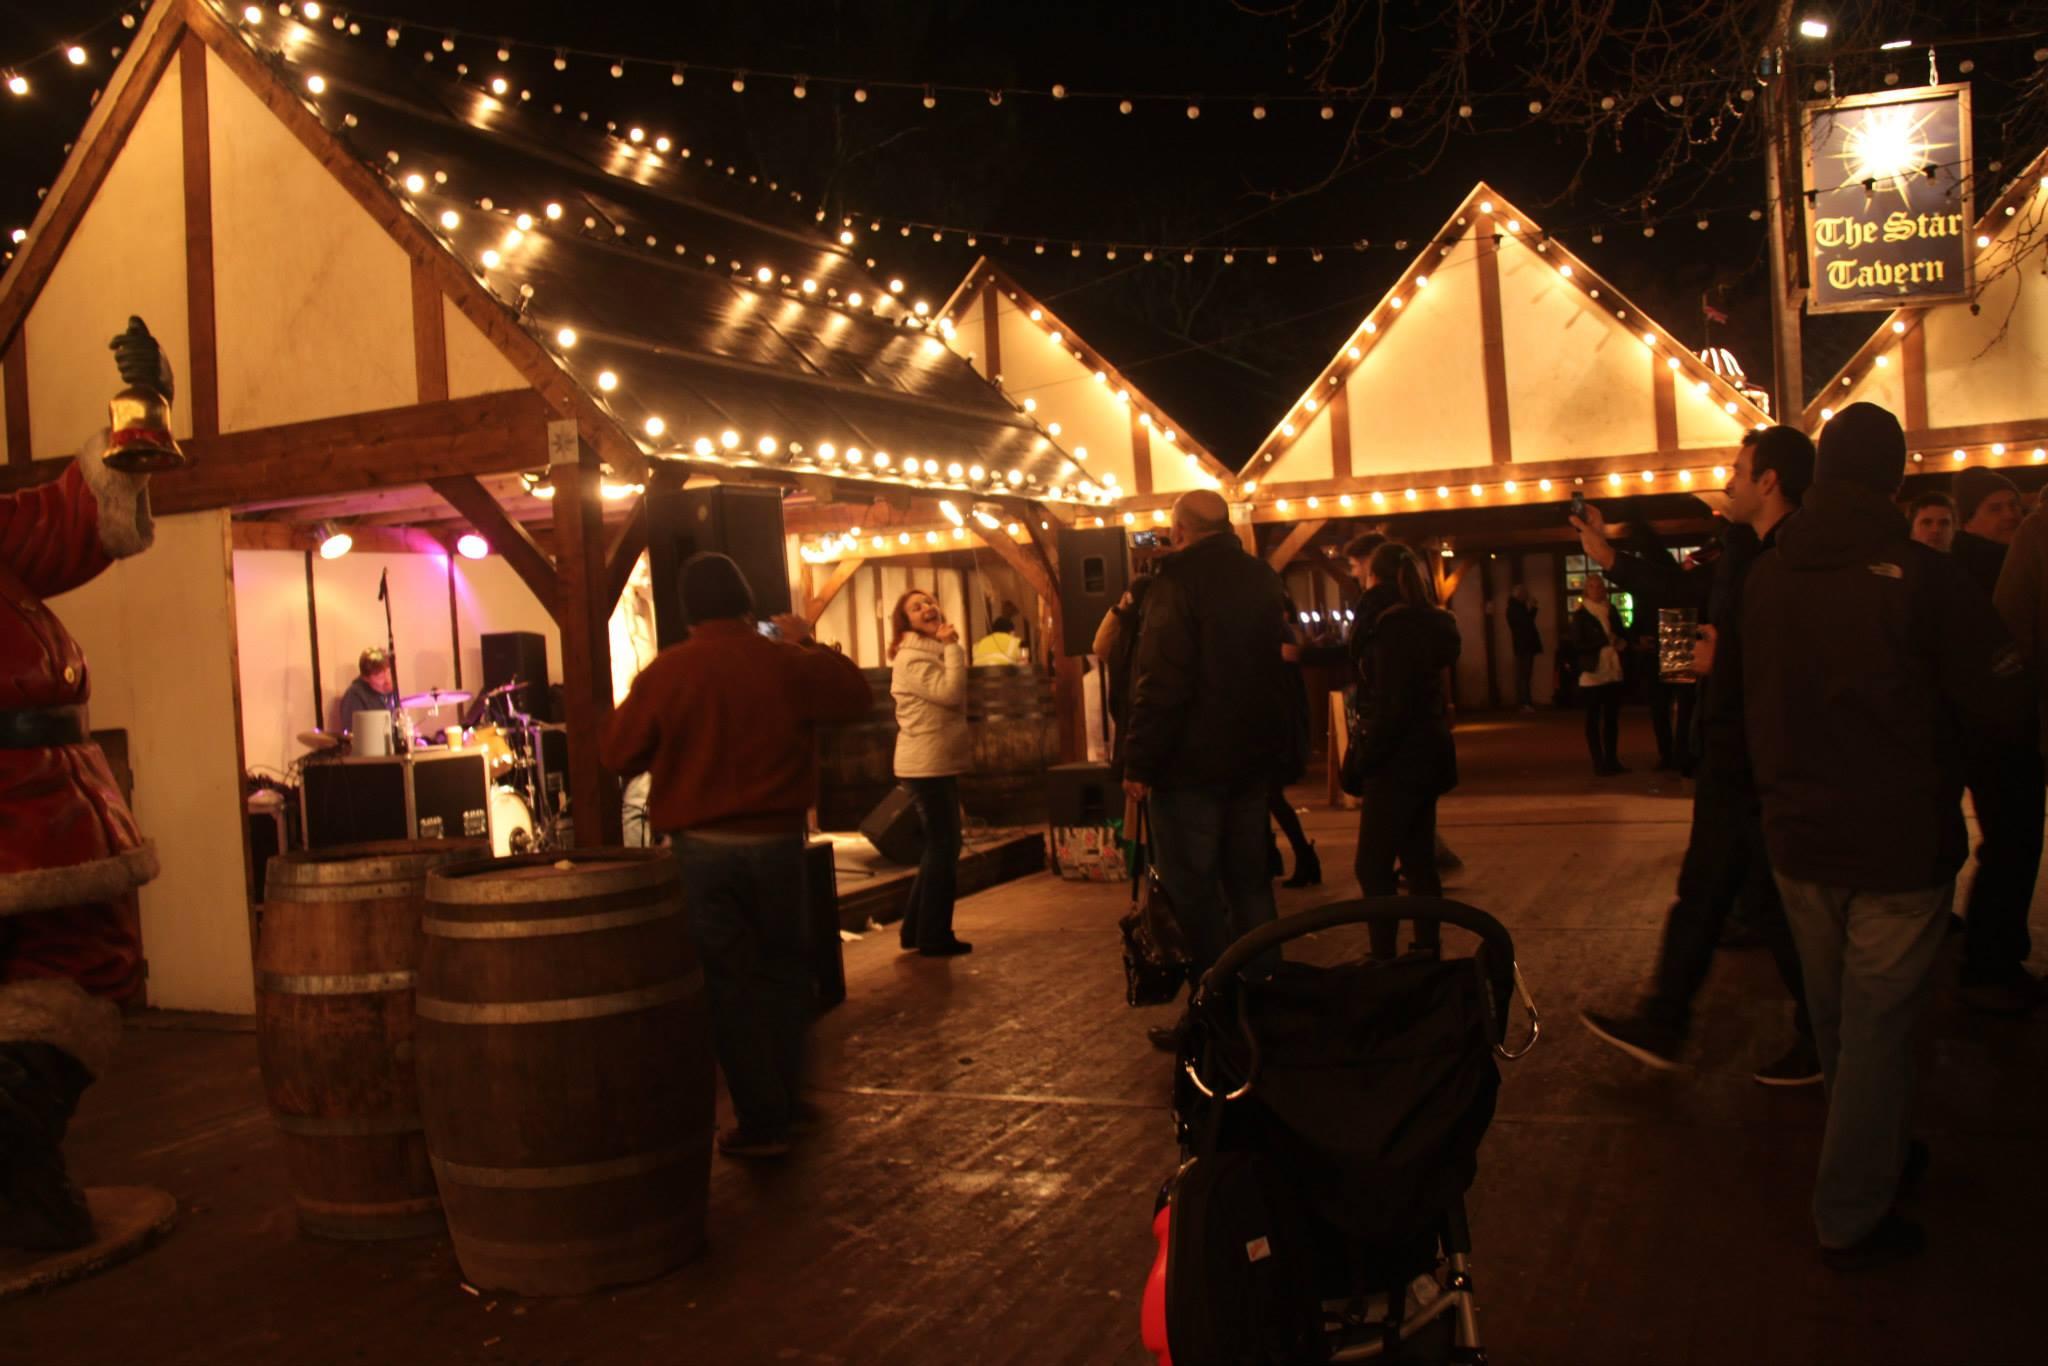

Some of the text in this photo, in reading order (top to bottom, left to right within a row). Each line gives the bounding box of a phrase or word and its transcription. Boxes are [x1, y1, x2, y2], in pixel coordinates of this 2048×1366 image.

[1816, 212, 1962, 249] The Star
[1827, 259, 1945, 290] Tavern
